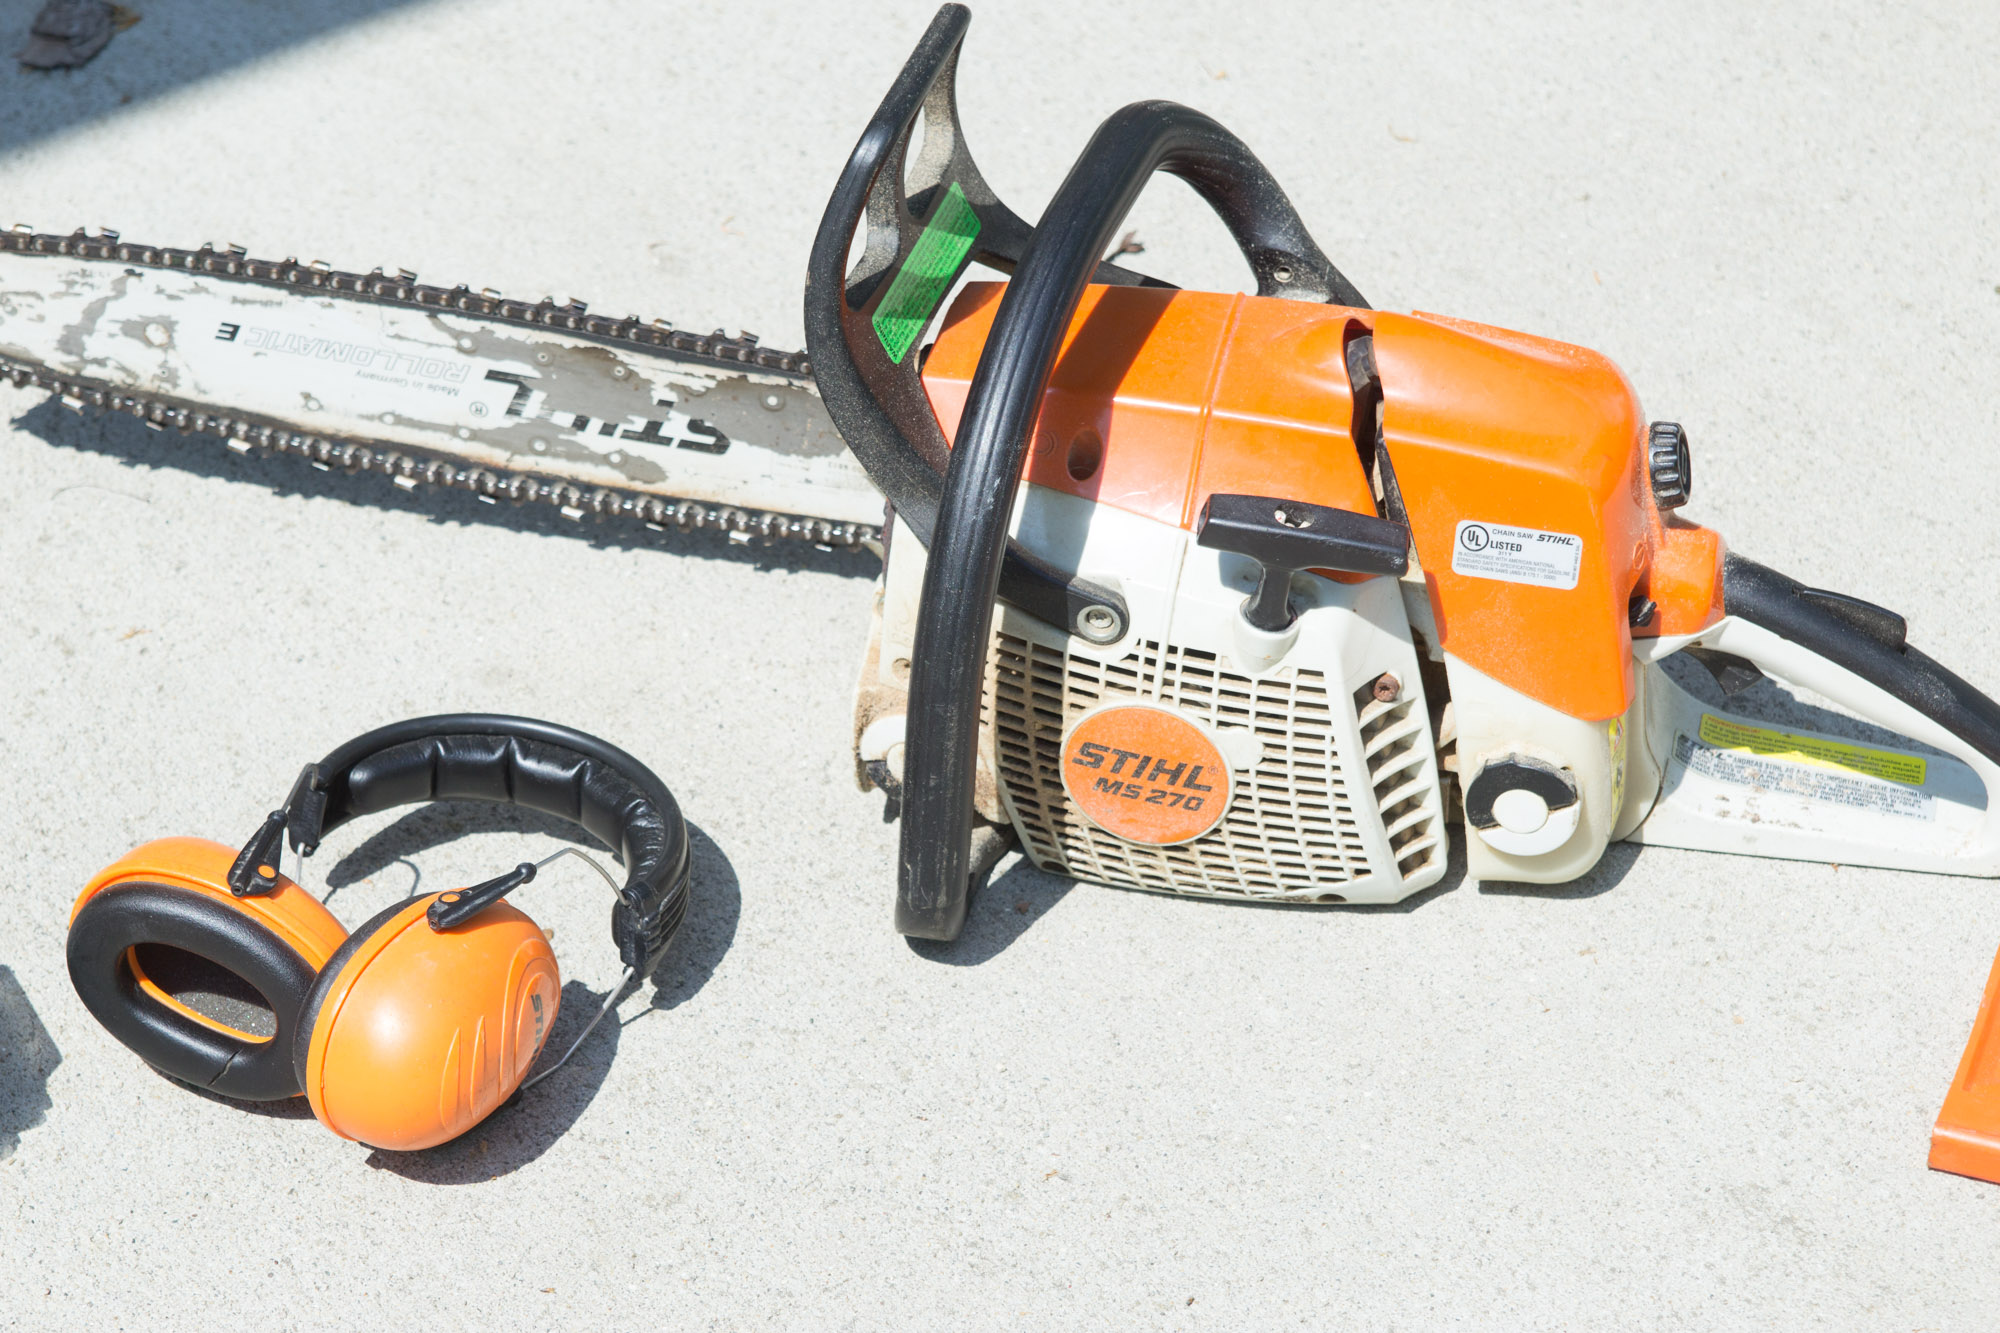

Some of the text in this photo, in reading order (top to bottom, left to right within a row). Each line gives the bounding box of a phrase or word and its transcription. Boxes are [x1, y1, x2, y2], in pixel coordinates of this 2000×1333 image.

[214, 322, 471, 384] ROLLOMATIC E
[354, 370, 460, 397] Made in Germany
[1492, 529, 1515, 537] CHAIN
[1537, 534, 1574, 546] STIHL
[1490, 540, 1522, 552] LISTED
[1464, 552, 1494, 560] ACCORDANCE
[1508, 557, 1531, 565] AMERICAN
[1533, 560, 1555, 568] NATIONAL
[1072, 741, 1212, 793] STIHL
[1092, 777, 1206, 812] MS 270
